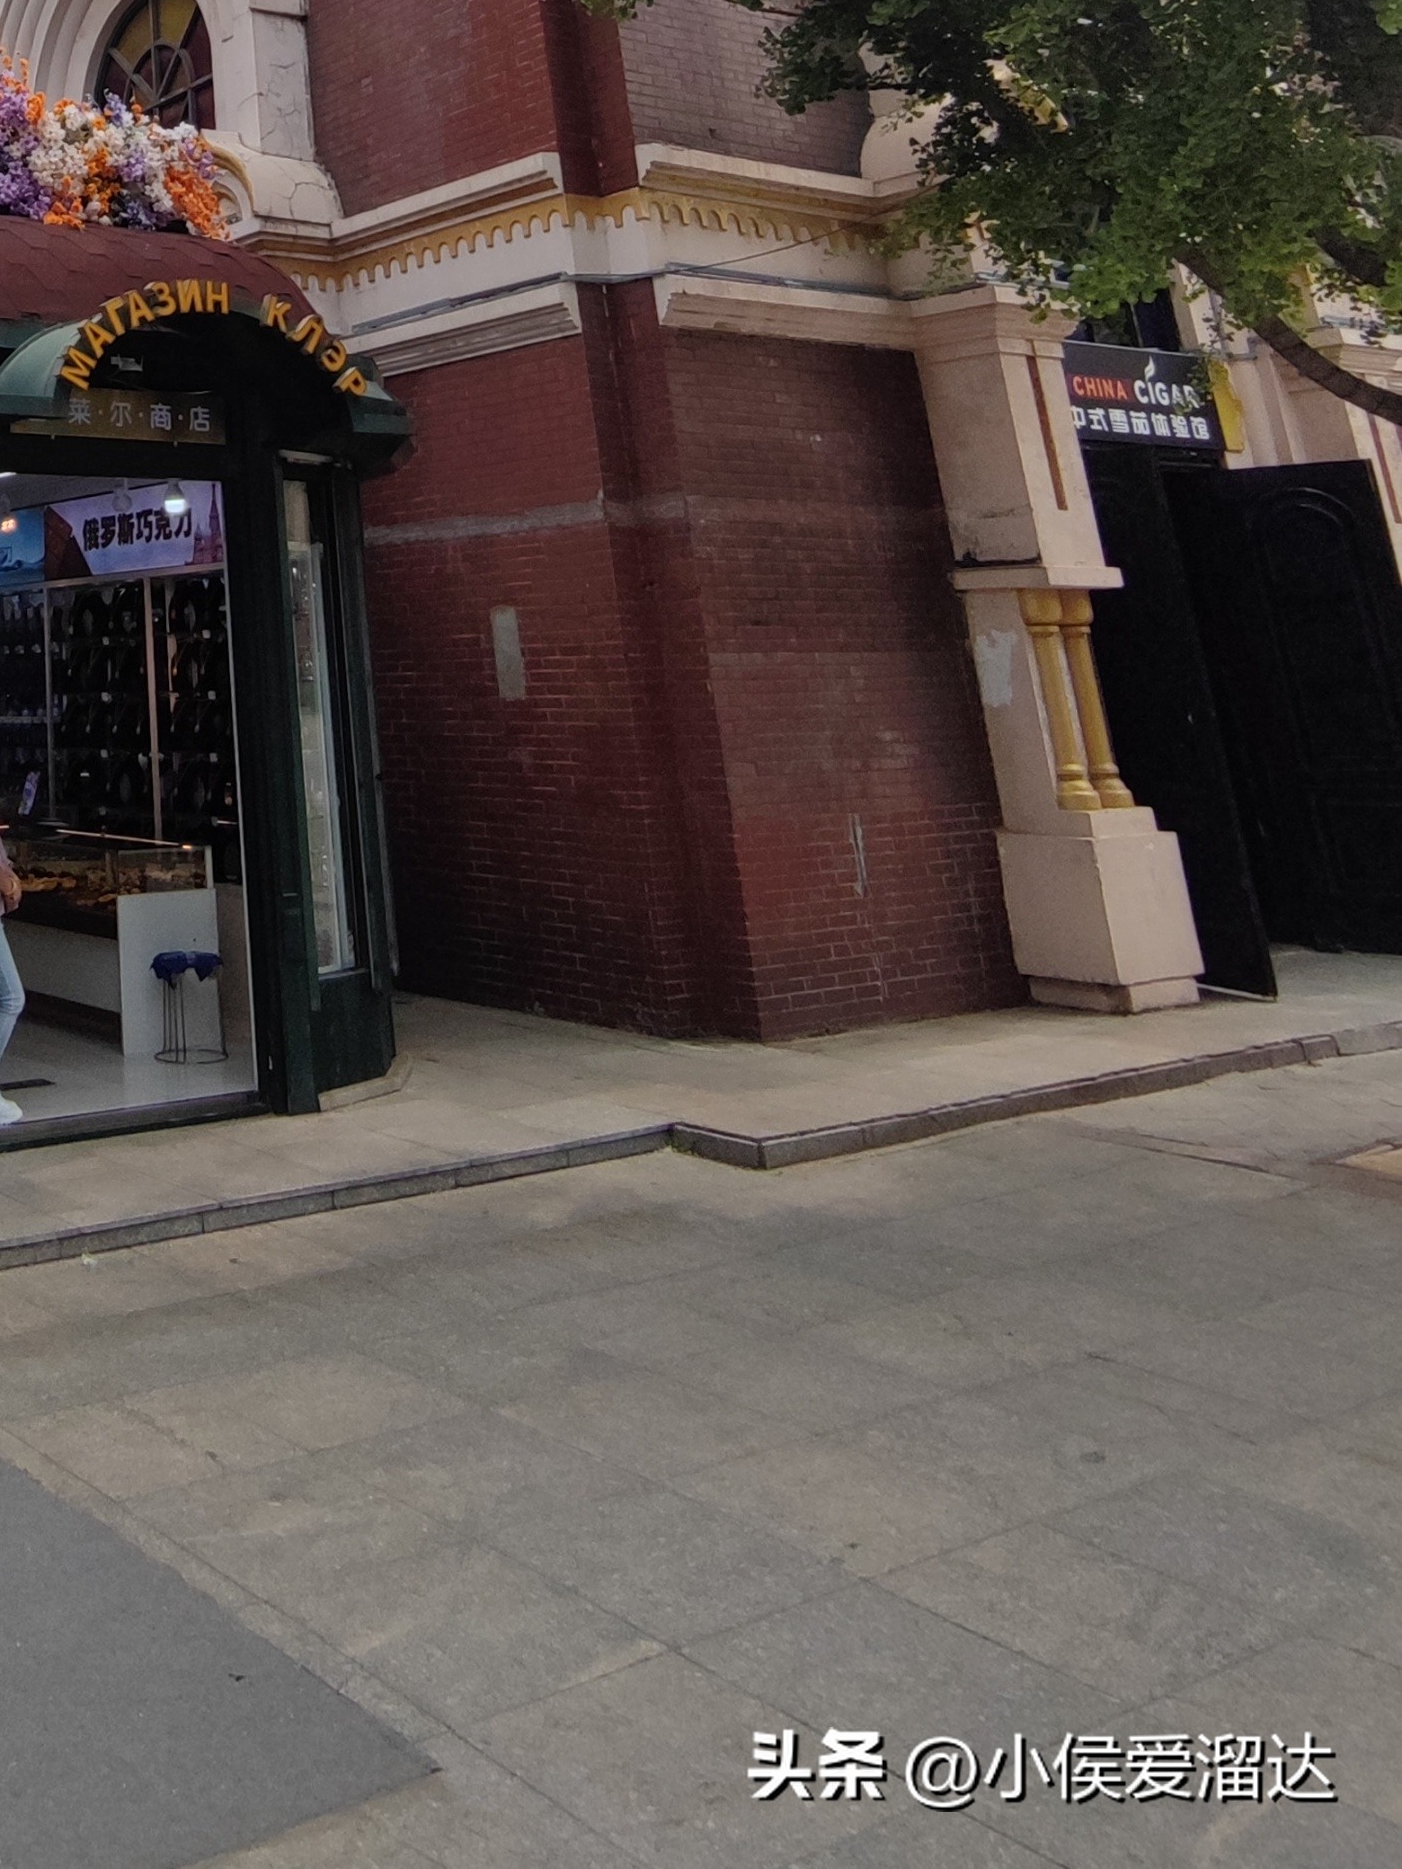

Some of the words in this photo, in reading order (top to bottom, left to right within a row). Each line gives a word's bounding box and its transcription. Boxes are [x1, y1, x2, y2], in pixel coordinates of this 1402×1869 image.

[59, 279, 230, 390] МАГАЗИН
[261, 293, 368, 398] КЛЭР
[1072, 375, 1128, 400] CHINA
[1070, 404, 1211, 440] 中式雪茄体验馆
[82, 505, 193, 552] 俄罗斯巧克力
